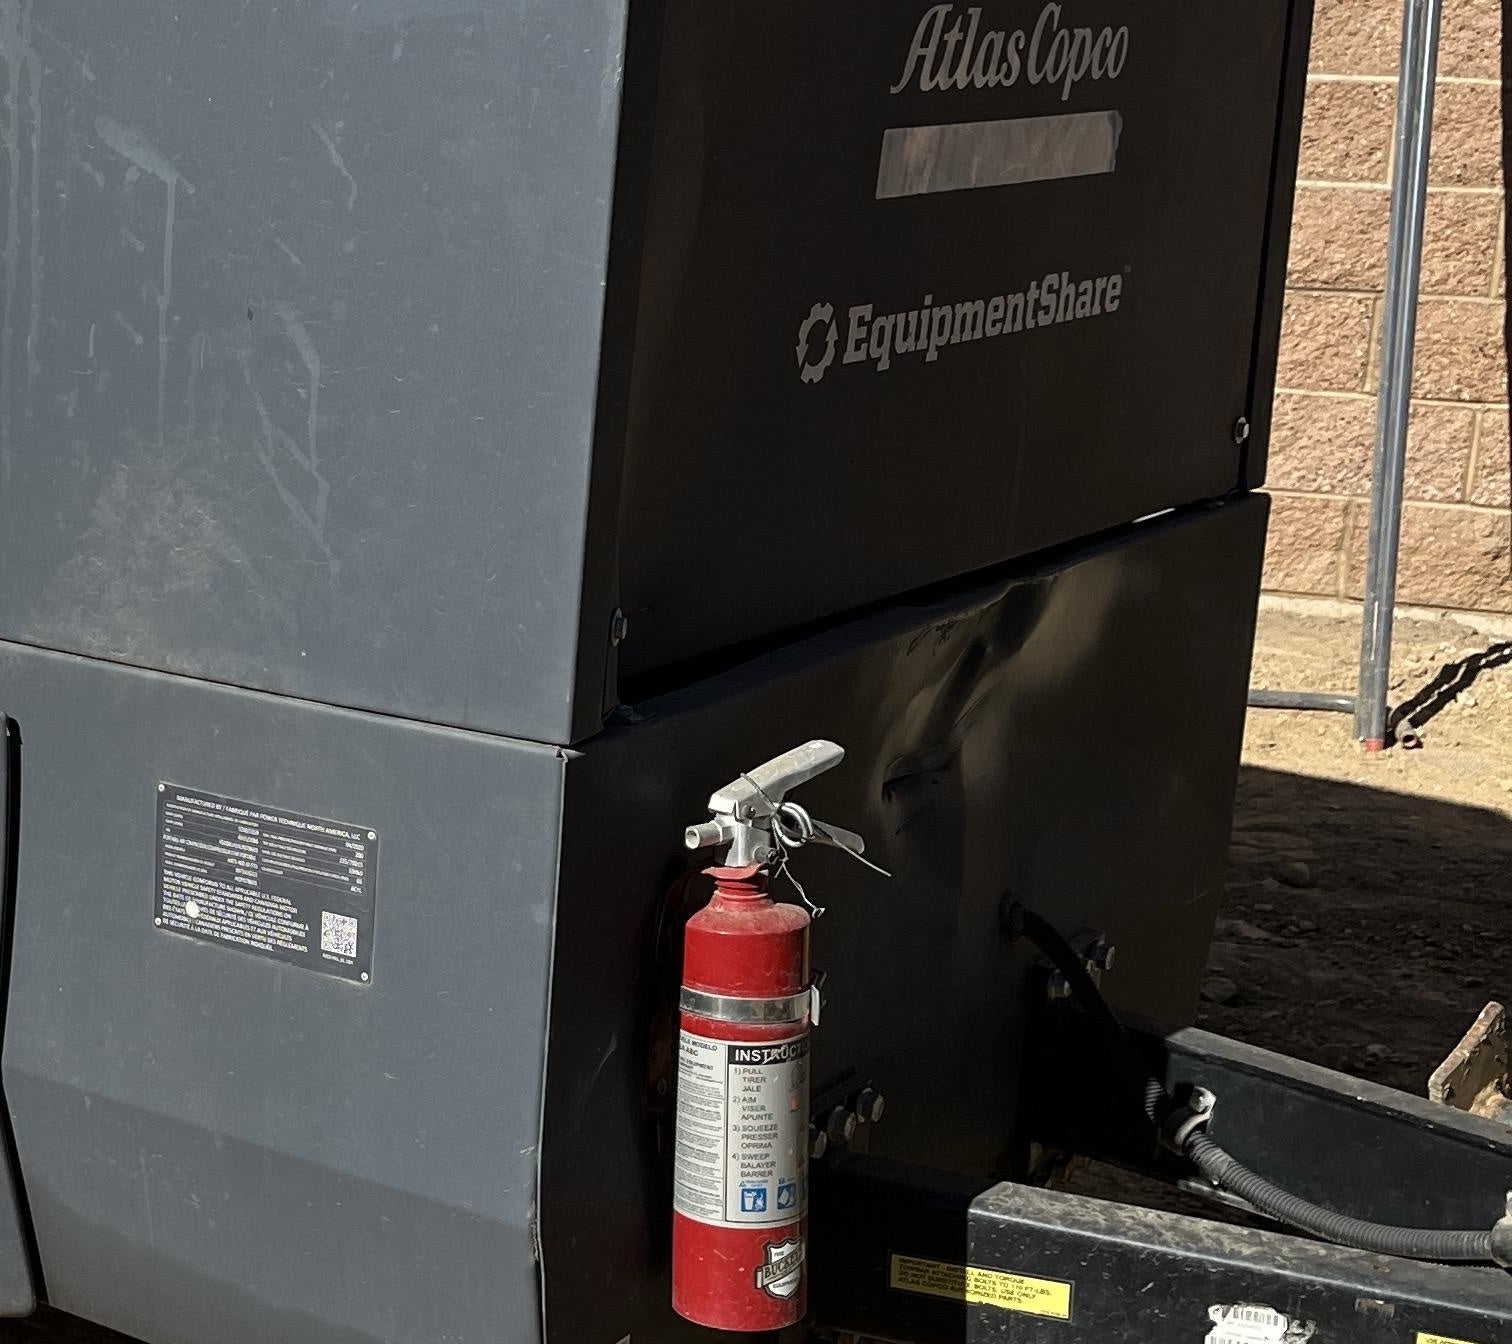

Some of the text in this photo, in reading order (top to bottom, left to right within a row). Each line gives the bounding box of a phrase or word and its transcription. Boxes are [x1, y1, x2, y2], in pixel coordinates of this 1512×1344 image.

[890, 2, 1130, 101] Atlas Copco
[842, 271, 1124, 372] EquipmentShare
